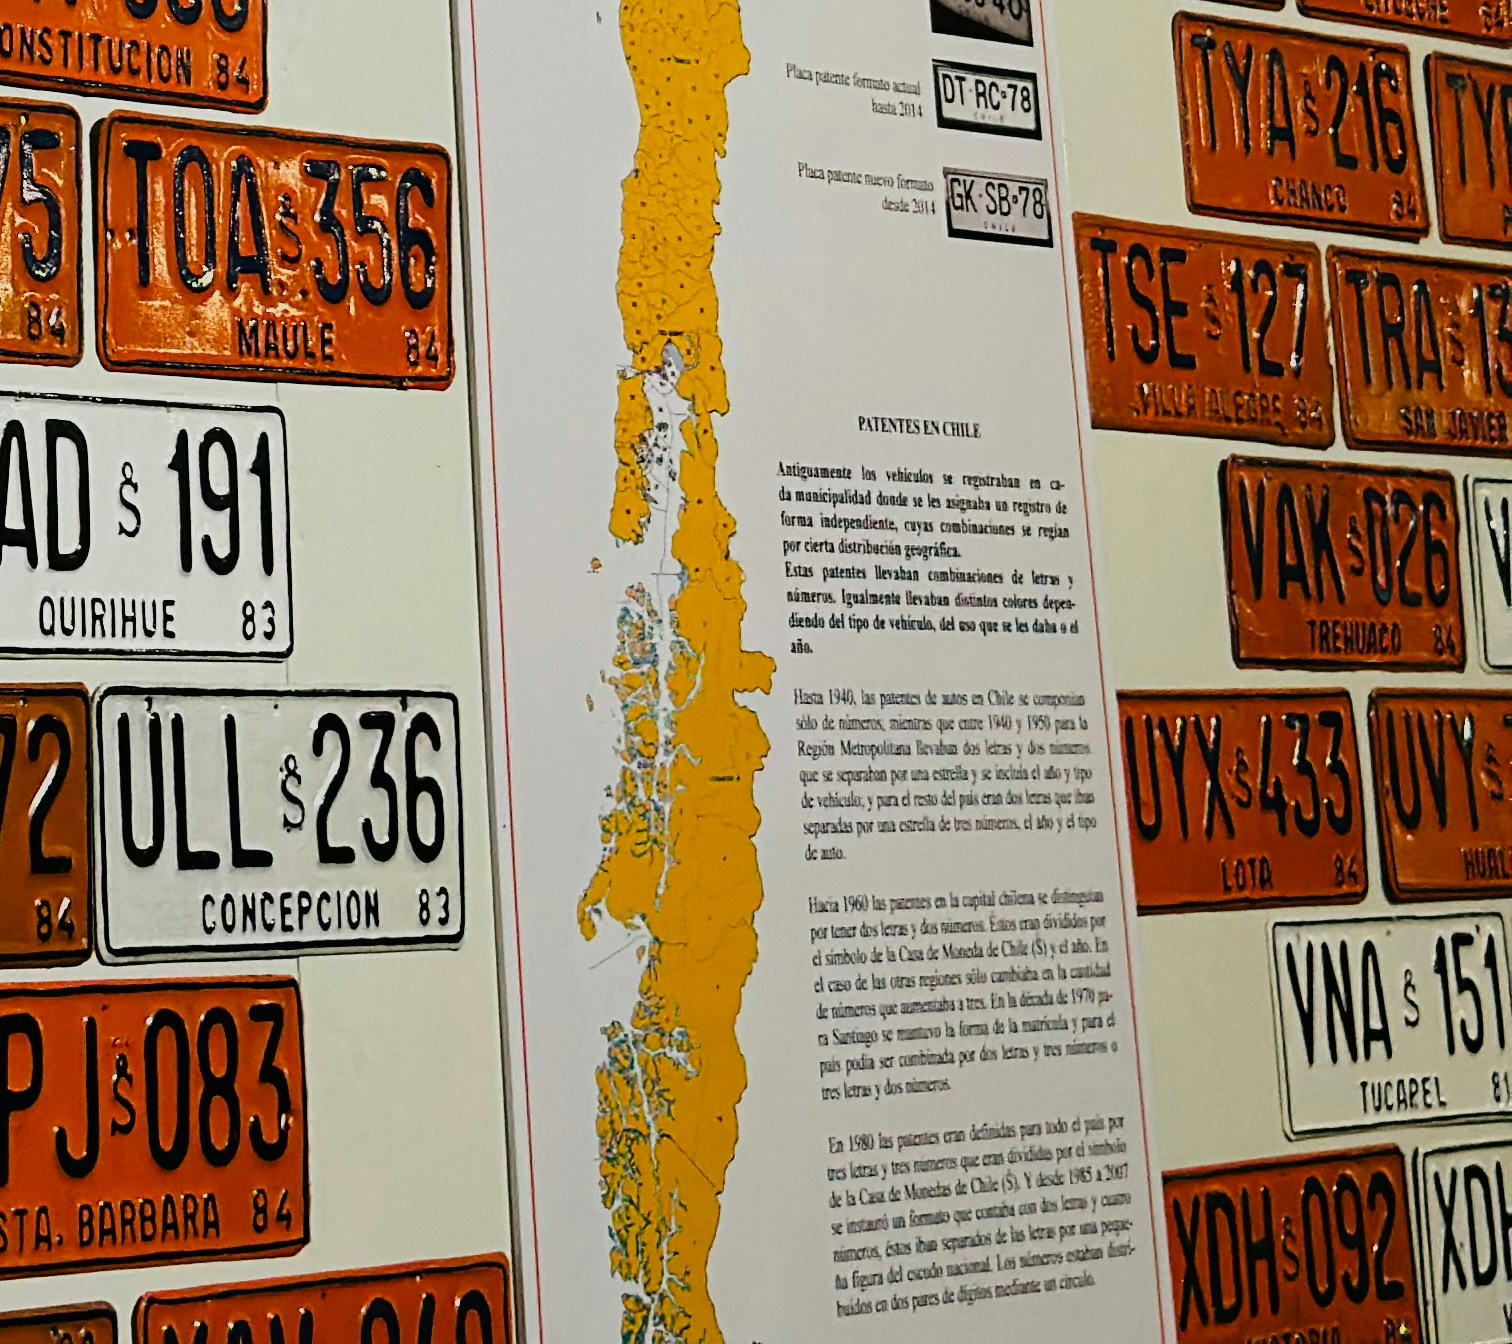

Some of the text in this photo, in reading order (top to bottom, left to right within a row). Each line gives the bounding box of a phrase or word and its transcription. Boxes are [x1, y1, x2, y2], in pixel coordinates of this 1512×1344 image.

[1271, 178, 1347, 213] CHANCO
[237, 316, 335, 363] MAULE
[858, 416, 981, 438] PATENTES EN CHILE
[777, 461, 851, 480] Antiguamente
[861, 465, 876, 482] los
[942, 472, 953, 485] se
[962, 472, 1020, 490] registraban
[38, 596, 277, 641] QUIRIHUE 83
[1307, 619, 1401, 656] TREHUACO
[1221, 856, 1273, 892] LOTA
[200, 889, 381, 933] CONCEPCION
[1361, 1076, 1448, 1112] TUCAPEL
[77, 1194, 221, 1247] BARBARA
